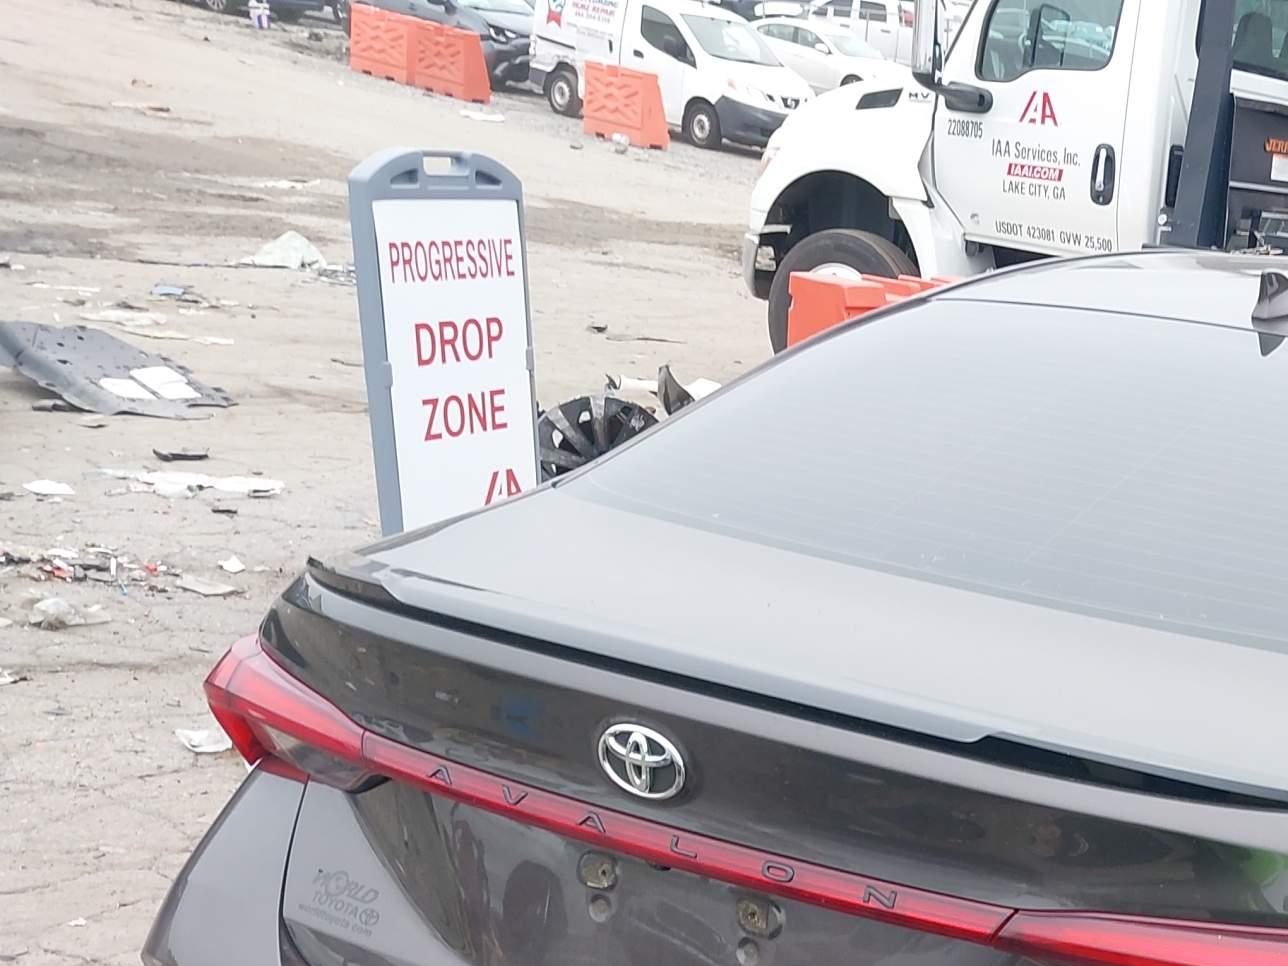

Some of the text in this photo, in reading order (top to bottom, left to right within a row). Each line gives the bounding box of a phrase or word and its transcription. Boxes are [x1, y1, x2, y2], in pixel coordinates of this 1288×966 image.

[947, 119, 984, 140] 22088705
[992, 138, 1081, 167] IAA Services, Inc.
[1010, 164, 1060, 181] IAAI.COM
[1002, 180, 1066, 201] LAKE CITY, GA
[995, 219, 1113, 252] USDOT 423081 GVW 25,500
[388, 239, 515, 284] PROGRESSIVE
[414, 317, 504, 367] DROP
[421, 389, 508, 442] ZONE
[427, 764, 898, 909] AVALON
[312, 890, 360, 920] TOYOTA
